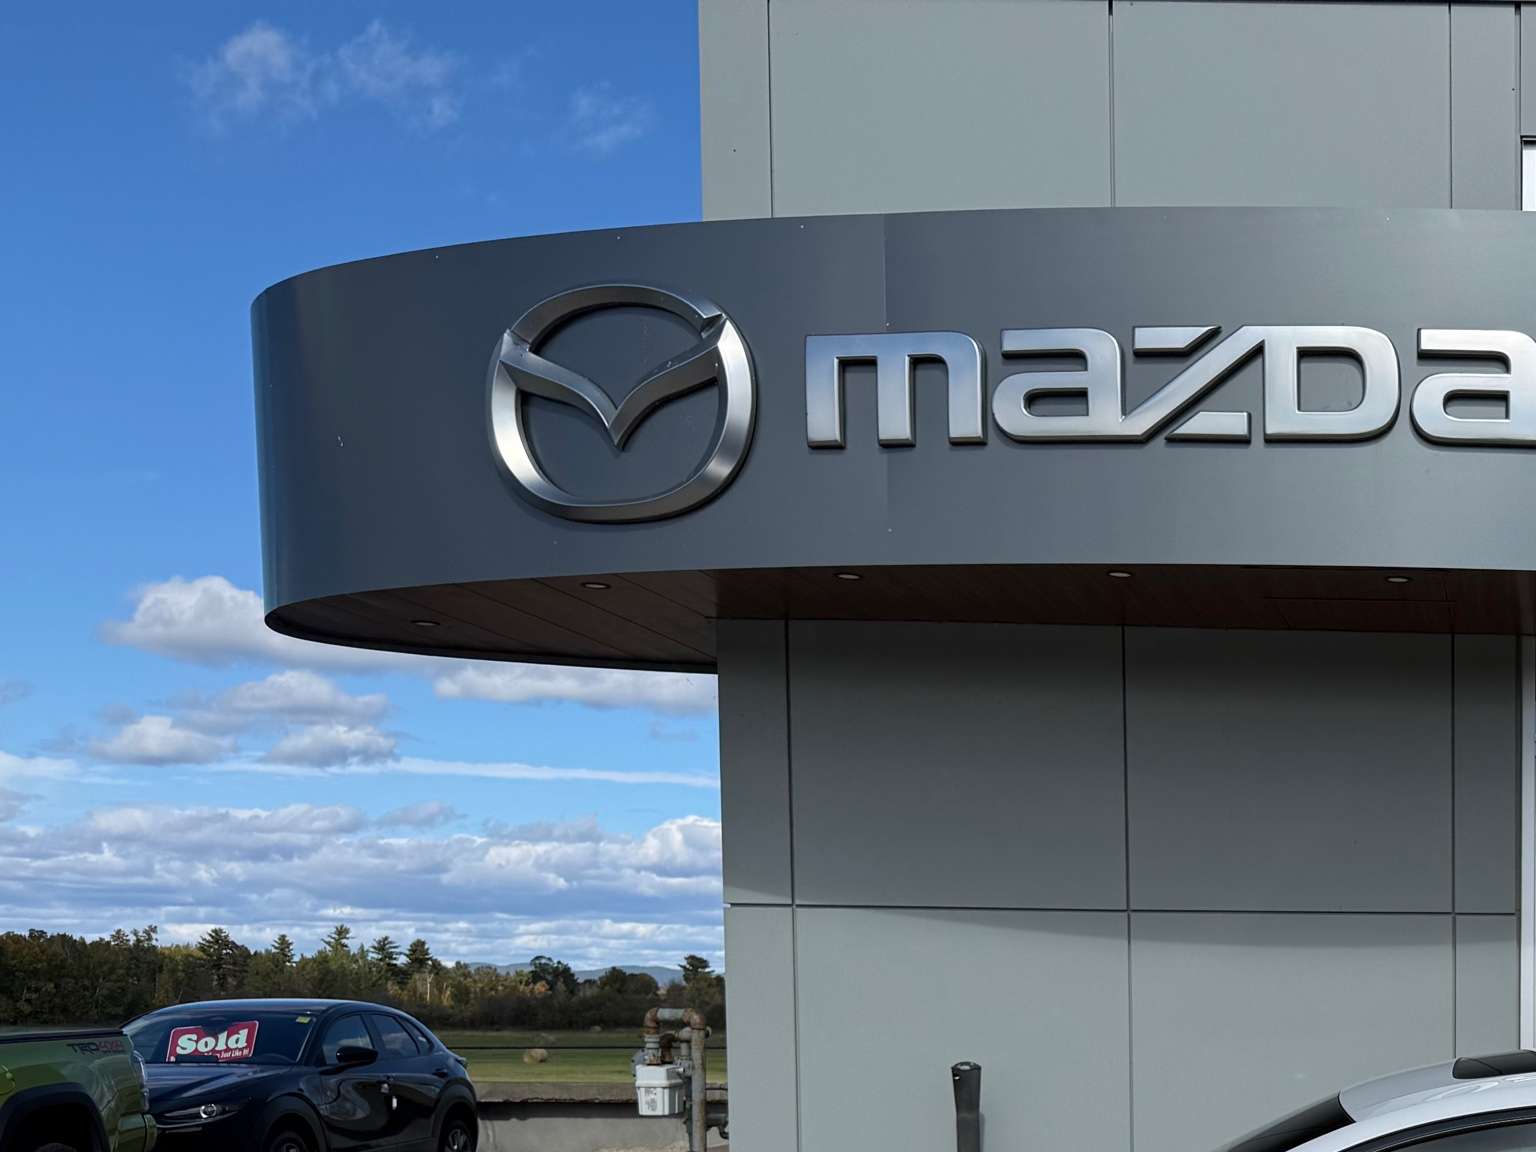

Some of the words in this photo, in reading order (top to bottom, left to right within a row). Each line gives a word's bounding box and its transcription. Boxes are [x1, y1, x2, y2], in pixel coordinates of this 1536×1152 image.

[175, 1028, 249, 1055] Sold
[220, 1050, 231, 1058] Just
[231, 1049, 242, 1057] Like
